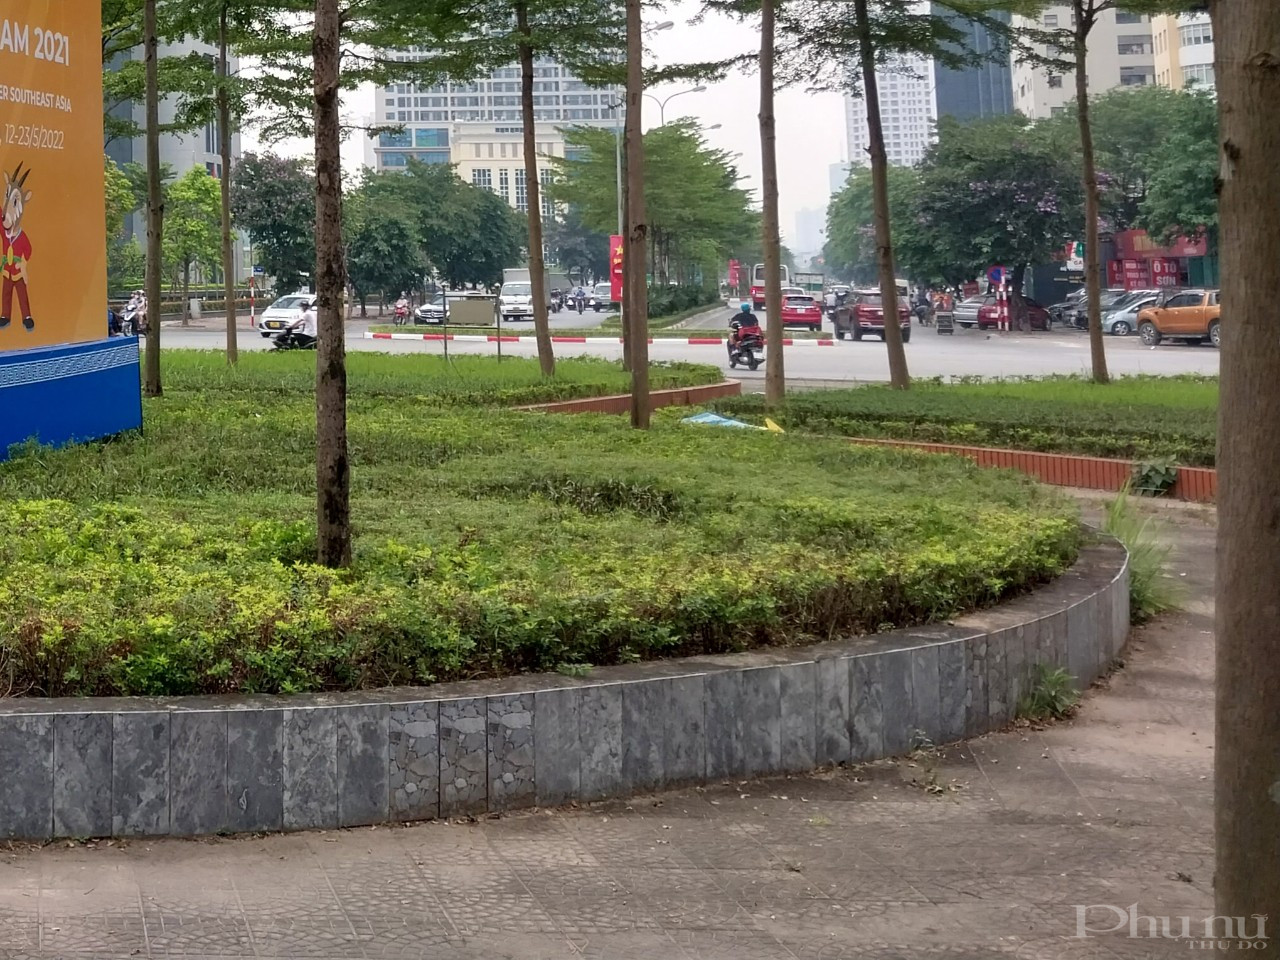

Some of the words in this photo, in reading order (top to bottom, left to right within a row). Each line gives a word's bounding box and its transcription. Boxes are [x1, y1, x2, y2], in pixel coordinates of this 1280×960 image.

[33, 27, 70, 67] 2021
[9, 86, 55, 109] SOUTHEAST
[55, 95, 72, 113] ASIA
[4, 123, 65, 150] 12-23/5/2022
